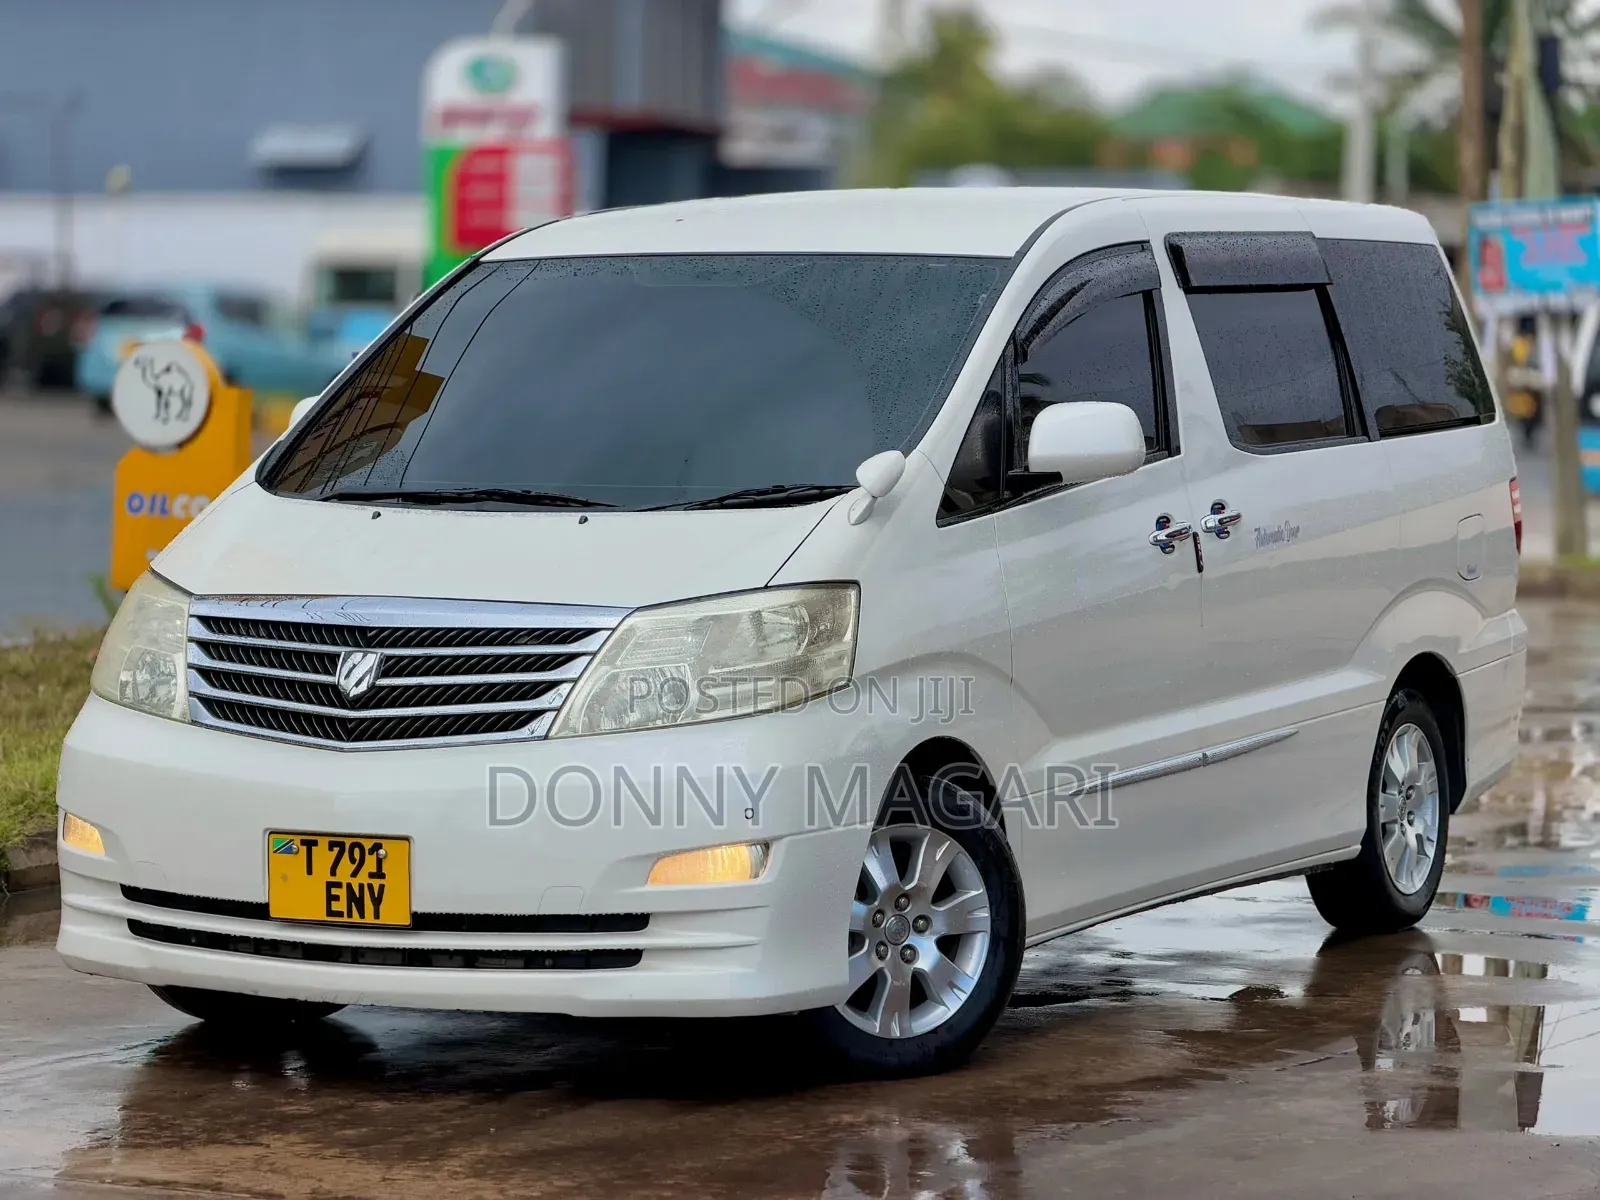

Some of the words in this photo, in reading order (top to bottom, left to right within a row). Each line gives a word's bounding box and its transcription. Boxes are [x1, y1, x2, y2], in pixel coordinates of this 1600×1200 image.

[300, 839, 318, 875] T
[328, 840, 386, 879] 791
[325, 881, 386, 920] ENY
